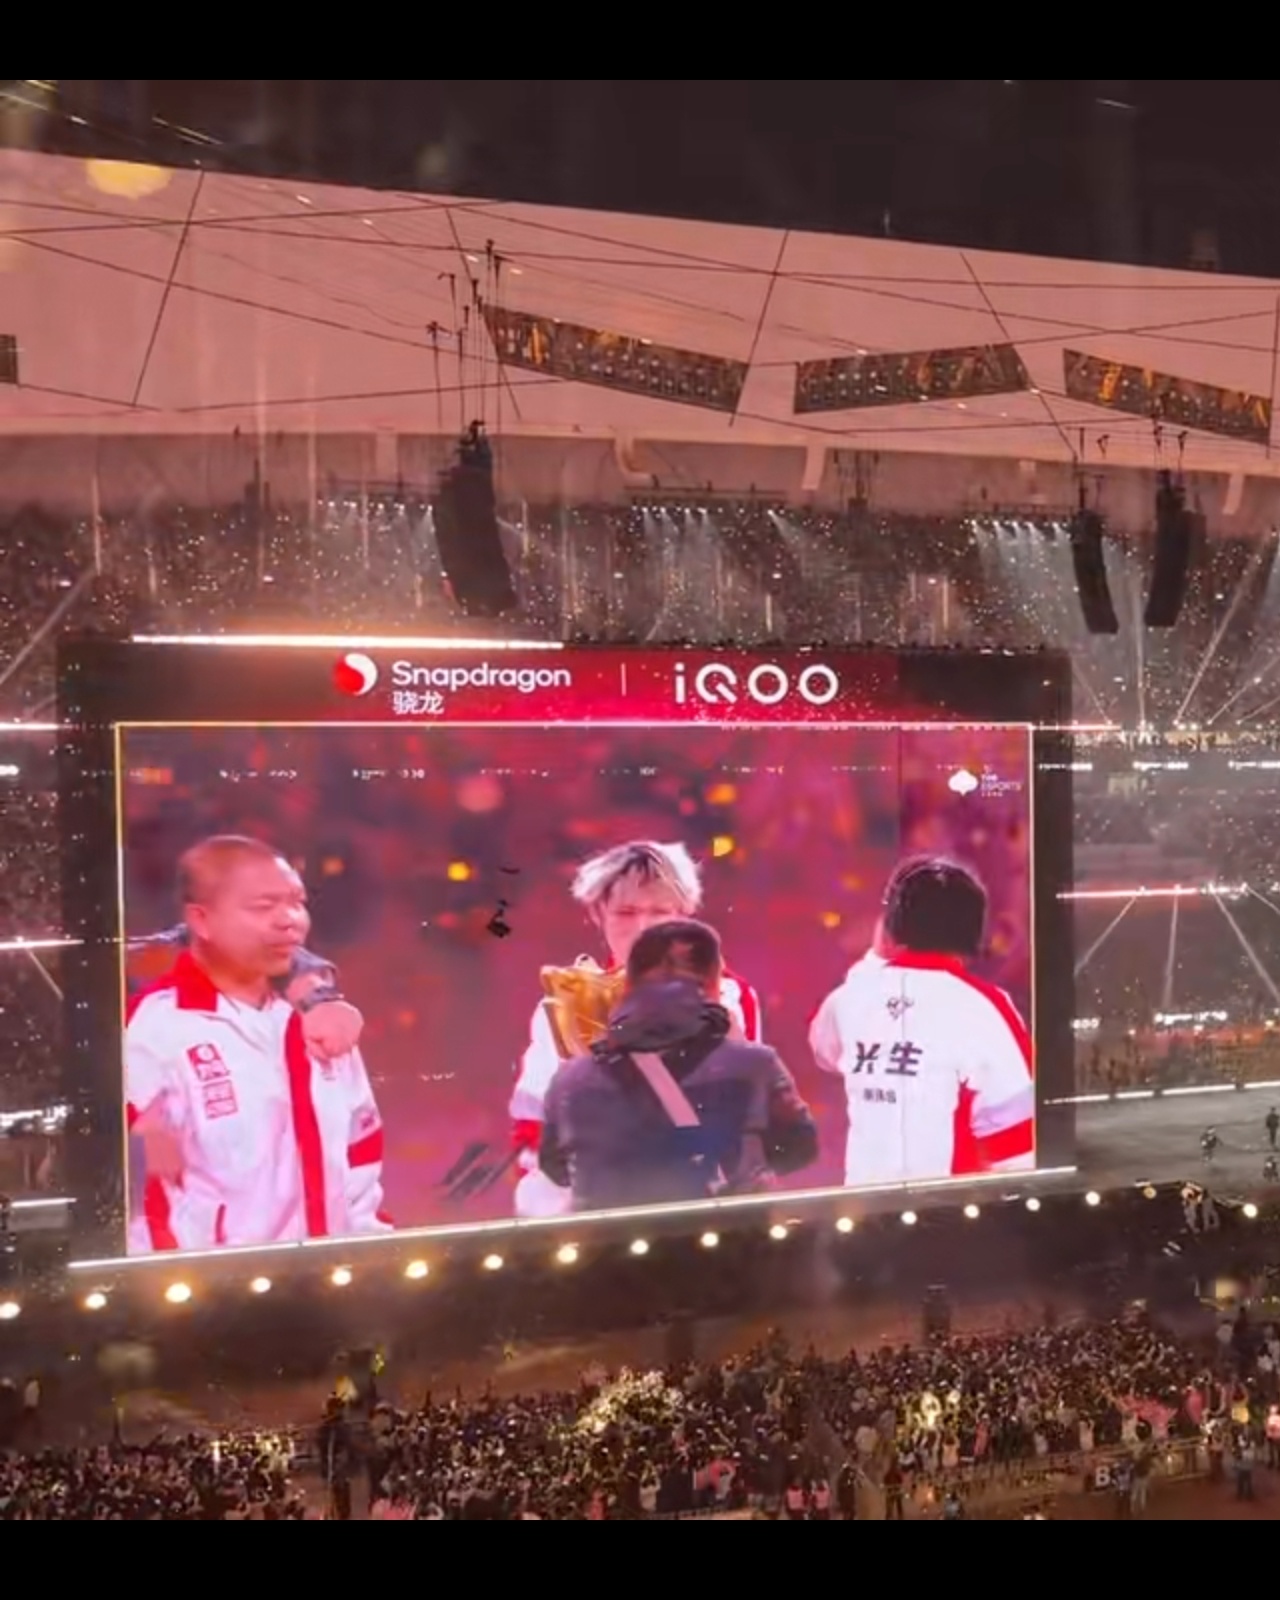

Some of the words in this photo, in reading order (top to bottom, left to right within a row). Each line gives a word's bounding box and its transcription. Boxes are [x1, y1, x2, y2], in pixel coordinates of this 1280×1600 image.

[392, 660, 572, 693] Snapdragon
[674, 661, 839, 705] iQOO
[392, 690, 445, 715] 骁龙
